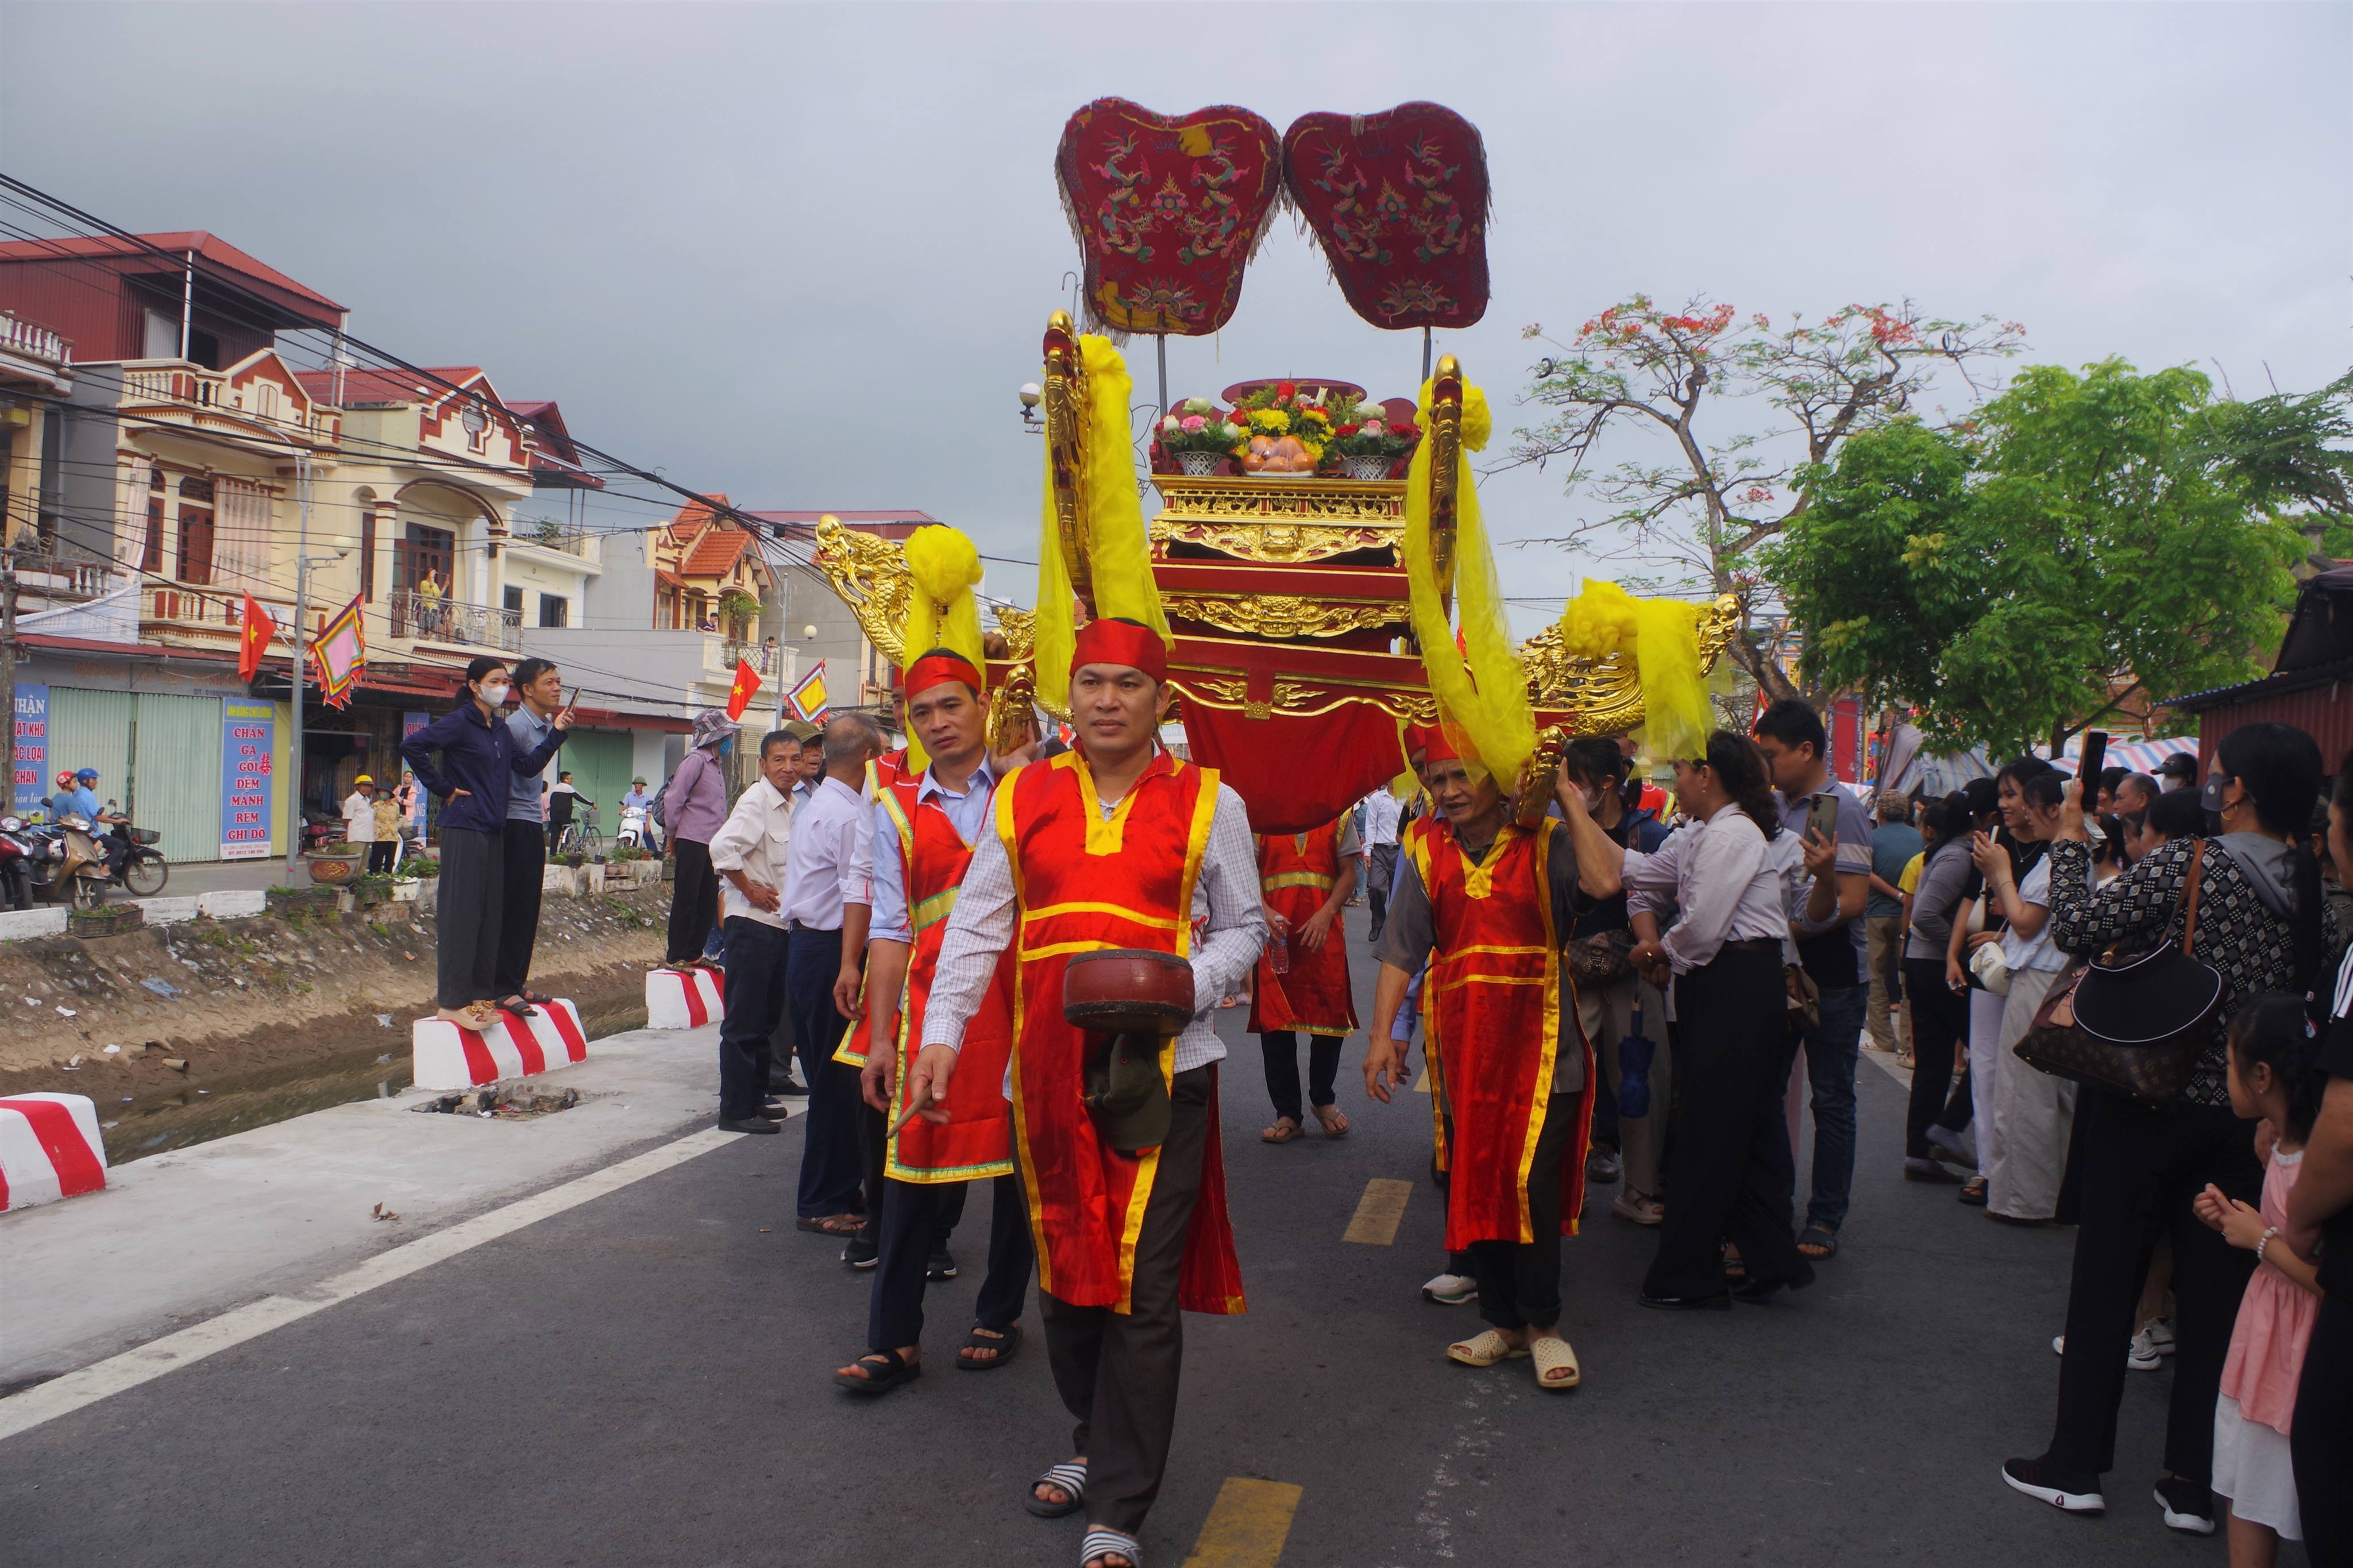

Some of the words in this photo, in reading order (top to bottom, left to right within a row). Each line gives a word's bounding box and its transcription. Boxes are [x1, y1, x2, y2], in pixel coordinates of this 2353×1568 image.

[14, 719, 26, 739] ẶT
[28, 719, 45, 737] KHÔ
[233, 725, 265, 739] CHĂN
[15, 742, 24, 760] ÁC
[26, 746, 45, 764] LOẠI
[241, 745, 257, 755] GA
[238, 758, 258, 772] GỐI
[236, 775, 260, 793] ĐỆM
[15, 793, 28, 805] hận
[231, 793, 264, 806] MÀNH
[236, 810, 259, 823] RÈM
[227, 829, 248, 841] GHI
